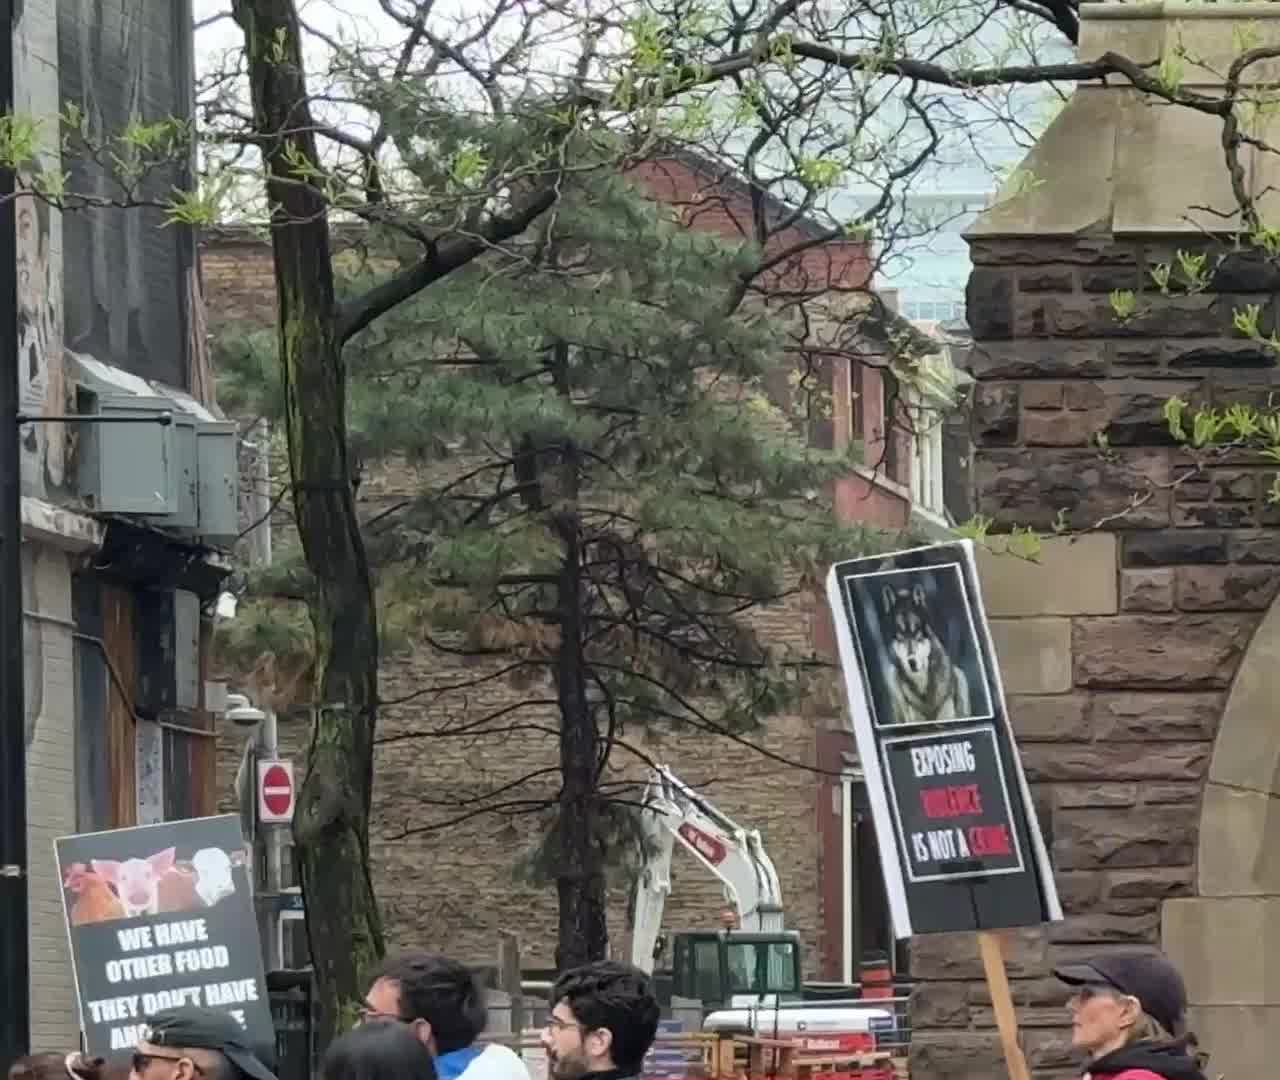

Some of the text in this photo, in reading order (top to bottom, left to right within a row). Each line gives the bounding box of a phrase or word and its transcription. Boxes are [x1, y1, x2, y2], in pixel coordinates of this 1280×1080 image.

[910, 741, 976, 778] EXPOSING
[911, 832, 929, 862] IS
[927, 829, 957, 860] NOT
[956, 827, 971, 857] A
[117, 918, 208, 951] WE HAVE
[105, 945, 229, 984] OTHER FOOD
[88, 996, 138, 1024] THEY
[205, 978, 259, 1006] HAVE
